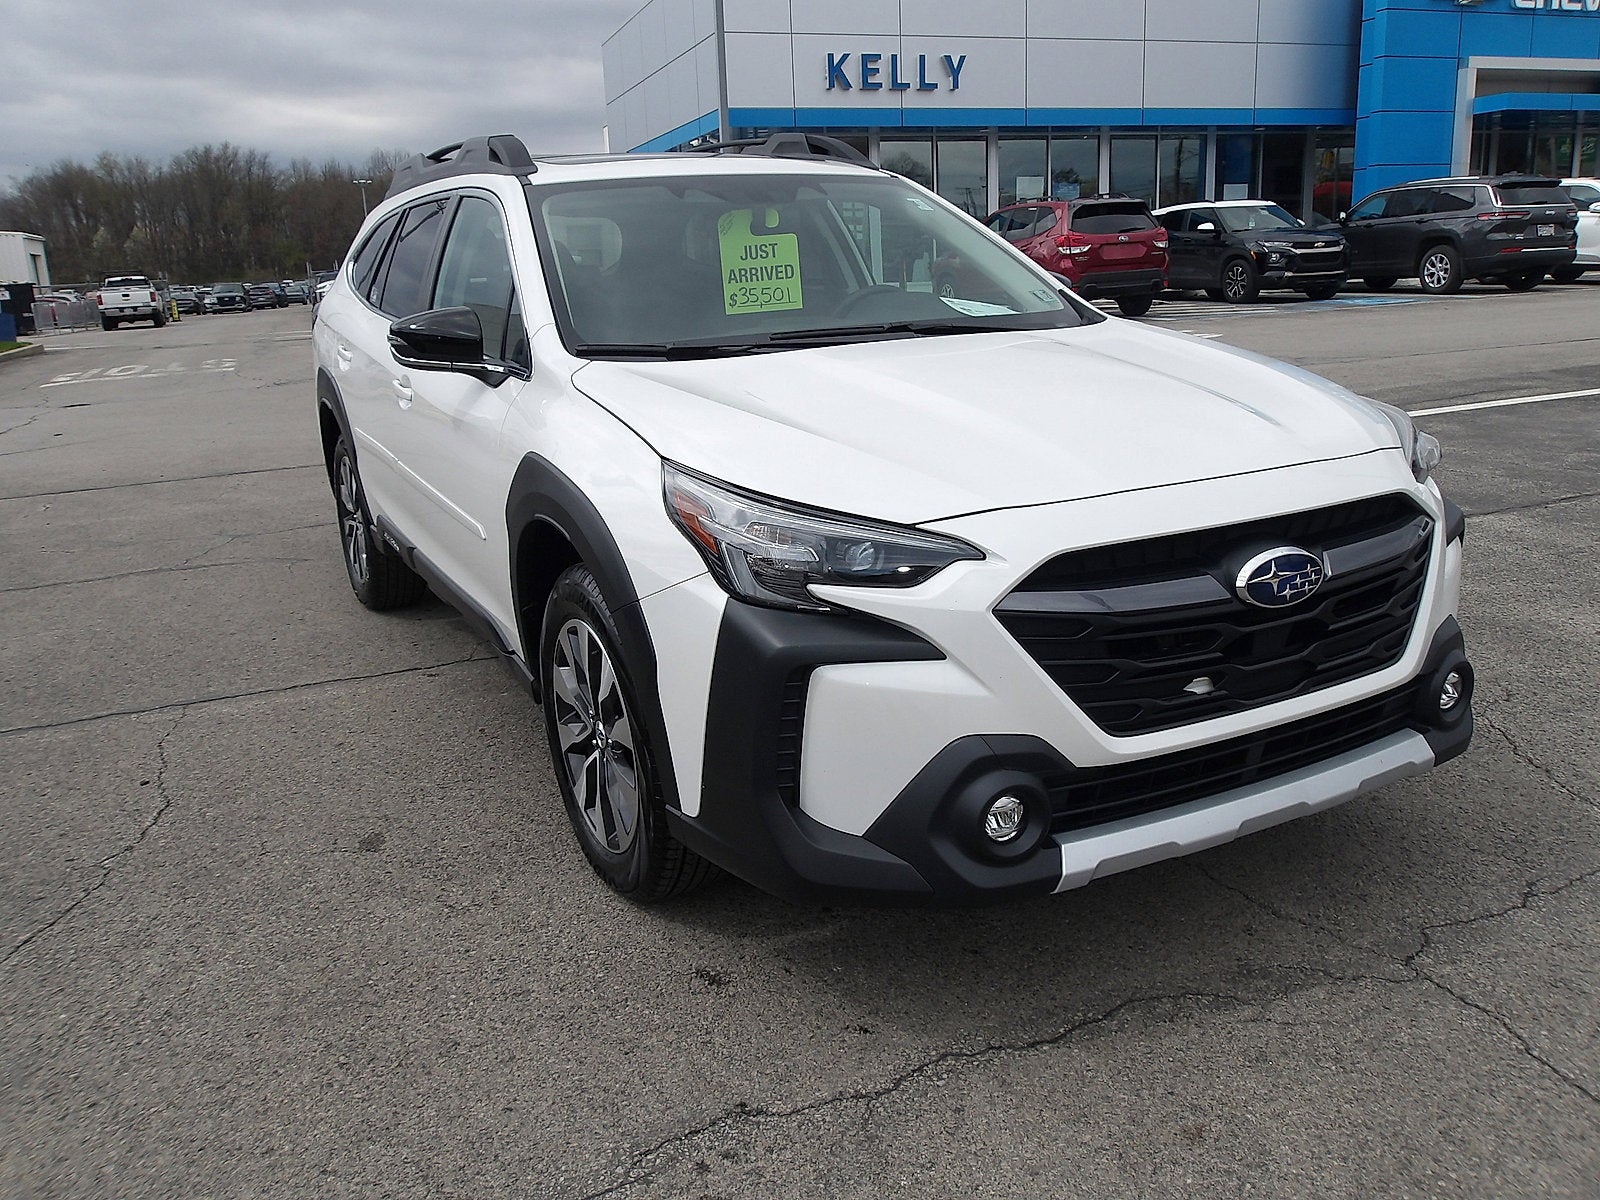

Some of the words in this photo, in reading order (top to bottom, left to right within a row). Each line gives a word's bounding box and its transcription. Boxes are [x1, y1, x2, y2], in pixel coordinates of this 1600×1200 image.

[826, 53, 967, 91] KELLY
[740, 243, 778, 261] JUST
[728, 264, 795, 284] ARRIVED
